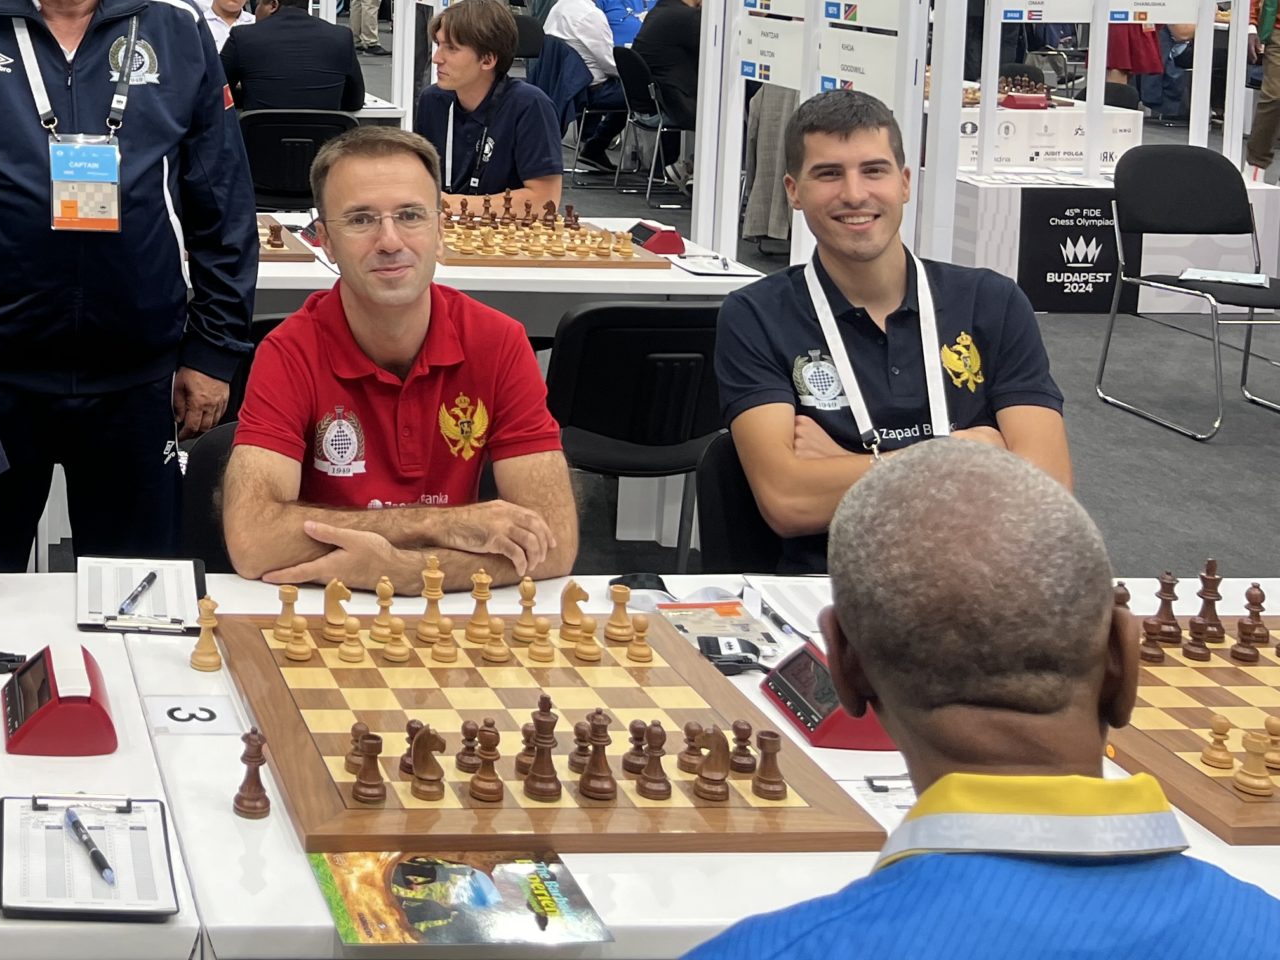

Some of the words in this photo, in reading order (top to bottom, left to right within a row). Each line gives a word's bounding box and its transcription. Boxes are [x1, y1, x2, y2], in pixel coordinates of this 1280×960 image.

[68, 161, 100, 169] CAPTAIN
[1082, 208, 1102, 217] FIDE
[1049, 217, 1074, 226] Chess
[1076, 217, 1115, 227] Olympiad
[1046, 272, 1112, 283] BUDAPEST
[1063, 283, 1093, 293] 2024
[879, 424, 920, 441] Zapad
[330, 466, 351, 475] 1949
[166, 706, 217, 723] 3
